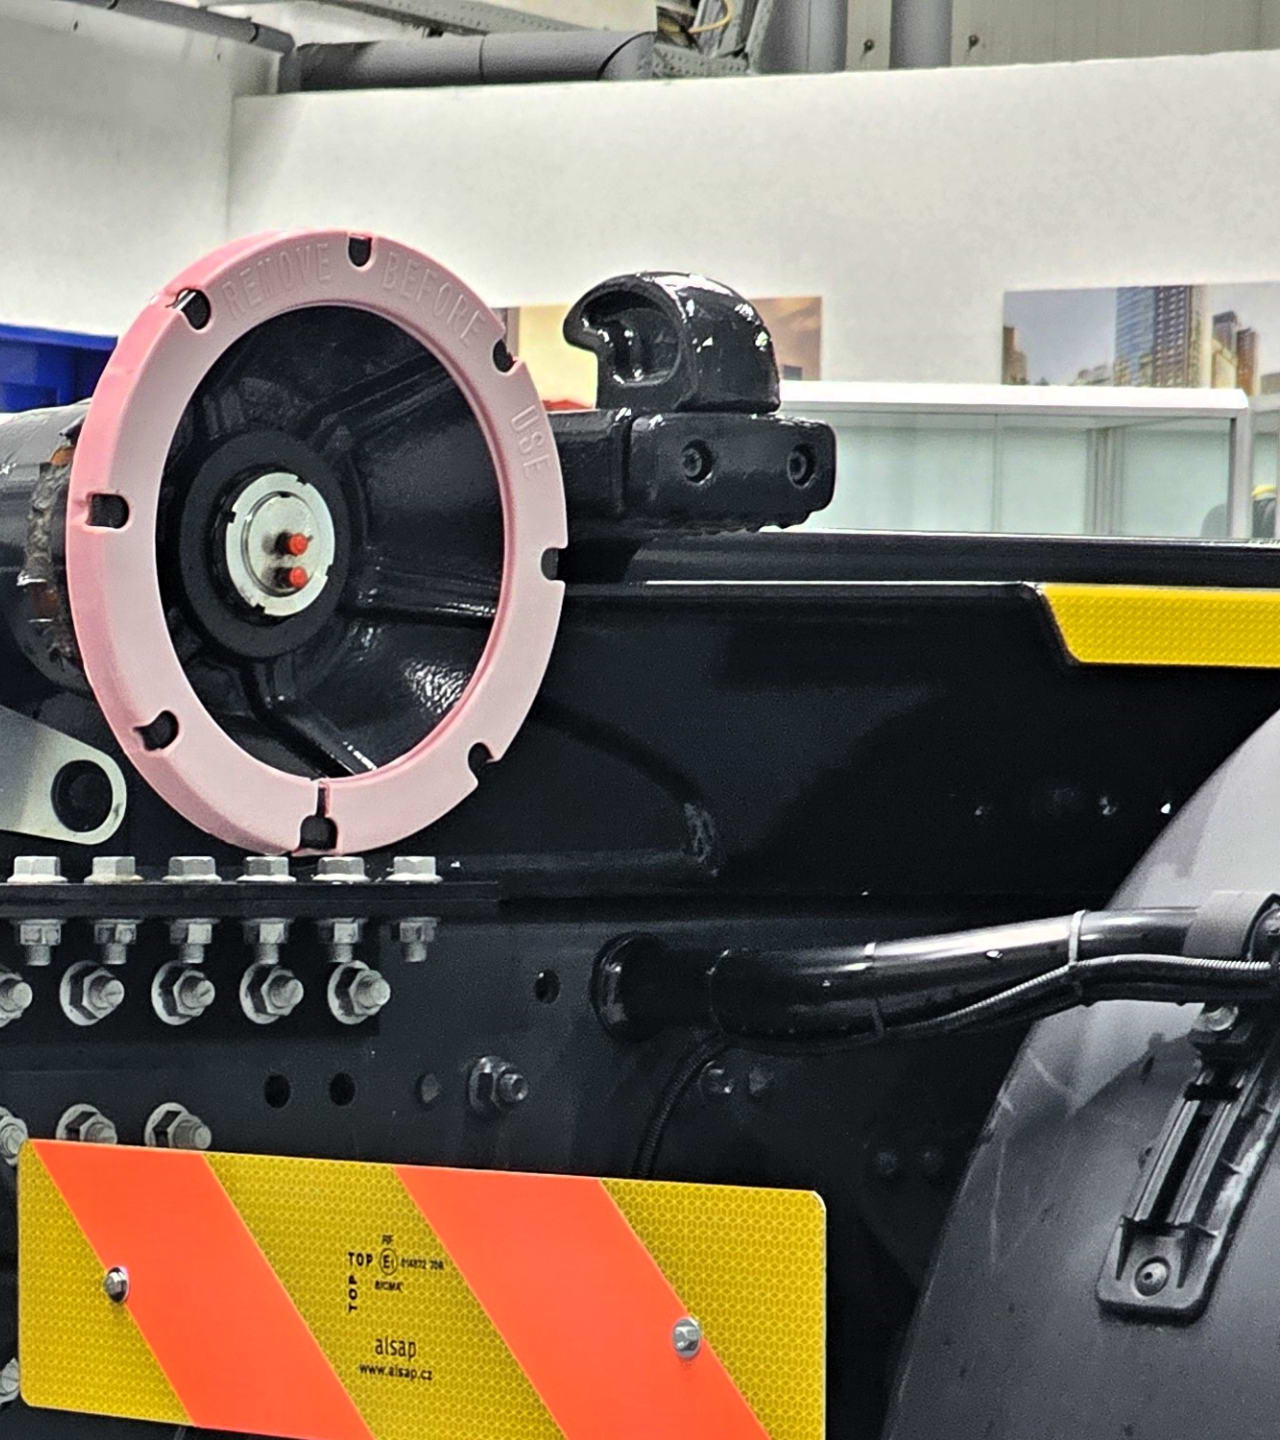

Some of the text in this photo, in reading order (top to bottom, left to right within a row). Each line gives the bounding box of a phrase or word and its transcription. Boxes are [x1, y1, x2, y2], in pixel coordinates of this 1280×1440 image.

[222, 243, 551, 479] REMOVE BEFORE USE
[348, 1252, 373, 1266] TOP
[348, 1274, 358, 1313] TOP
[375, 1336, 417, 1361] alsap
[359, 1363, 433, 1381] www.alsap.cz
